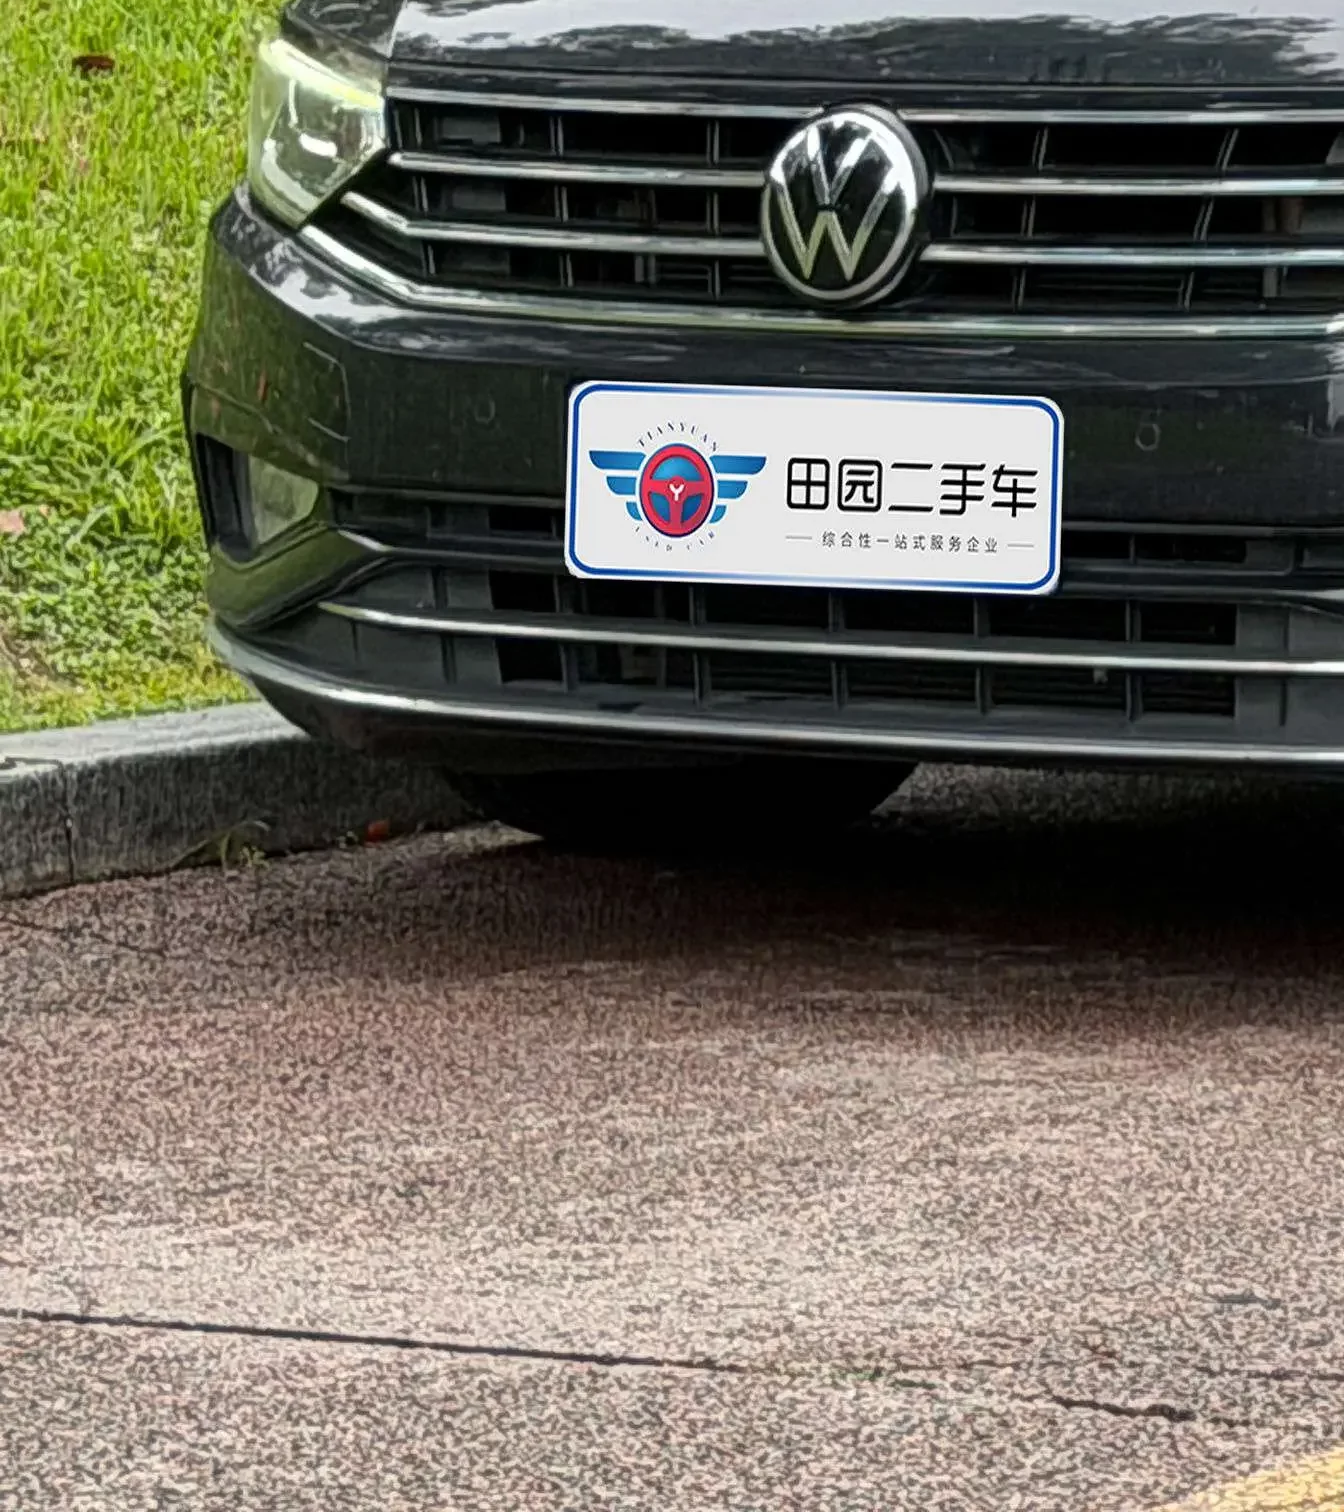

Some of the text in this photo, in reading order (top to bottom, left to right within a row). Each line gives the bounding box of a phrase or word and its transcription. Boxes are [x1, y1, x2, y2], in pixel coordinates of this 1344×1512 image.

[786, 457, 1039, 518] 田园二手车
[821, 530, 998, 554] 综合性一站式服务企业
